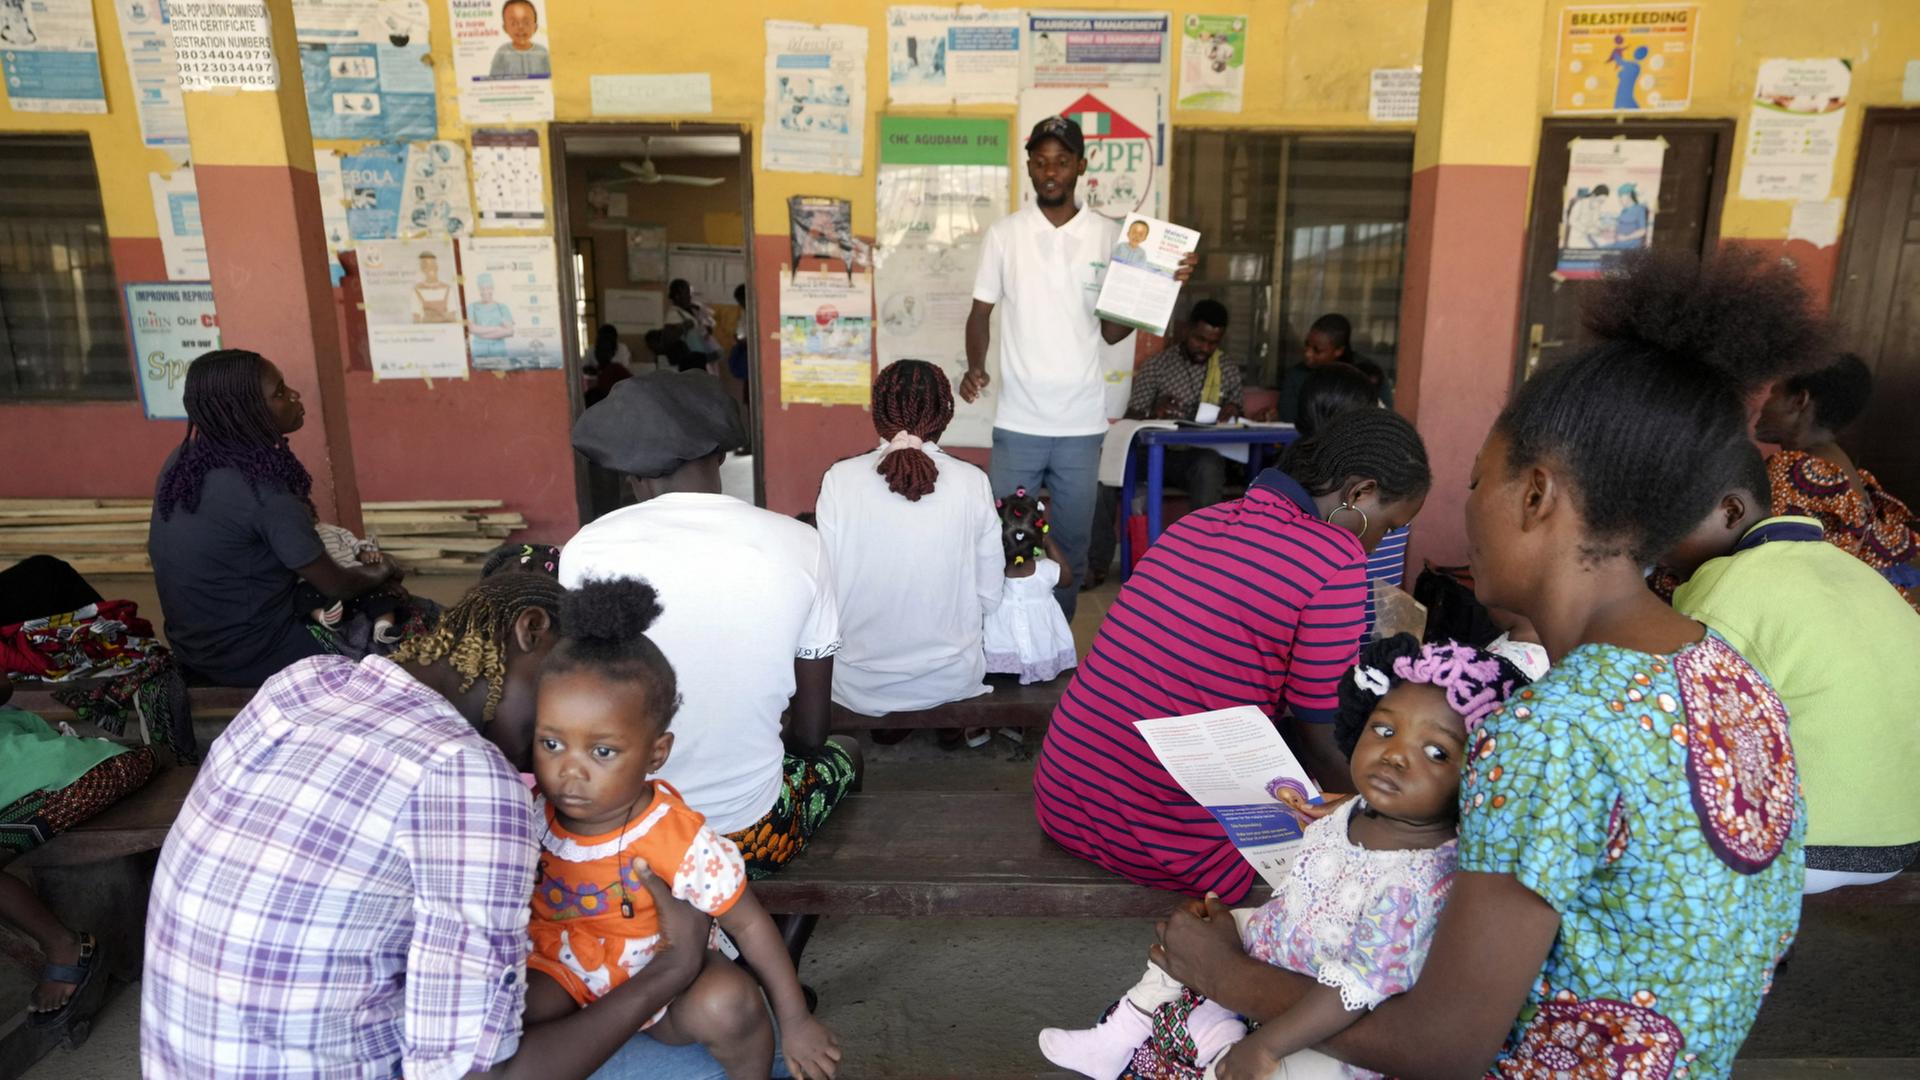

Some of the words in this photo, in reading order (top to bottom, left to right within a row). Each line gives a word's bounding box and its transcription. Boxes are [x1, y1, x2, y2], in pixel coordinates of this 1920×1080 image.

[186, 4, 226, 17] POPULATION
[1571, 10, 1688, 26] BREASTFEEDING
[172, 19, 198, 31] BIRTH
[200, 19, 256, 32] CERTIFICATE
[1094, 19, 1163, 31] MANAGEMENT
[173, 36, 226, 48] GISTRATION
[228, 37, 271, 48] NUMBERS
[914, 133, 968, 145] AGUDAMA
[976, 135, 999, 147] EPIE
[136, 291, 180, 302] IMPROVING
[177, 316, 197, 326] Our
